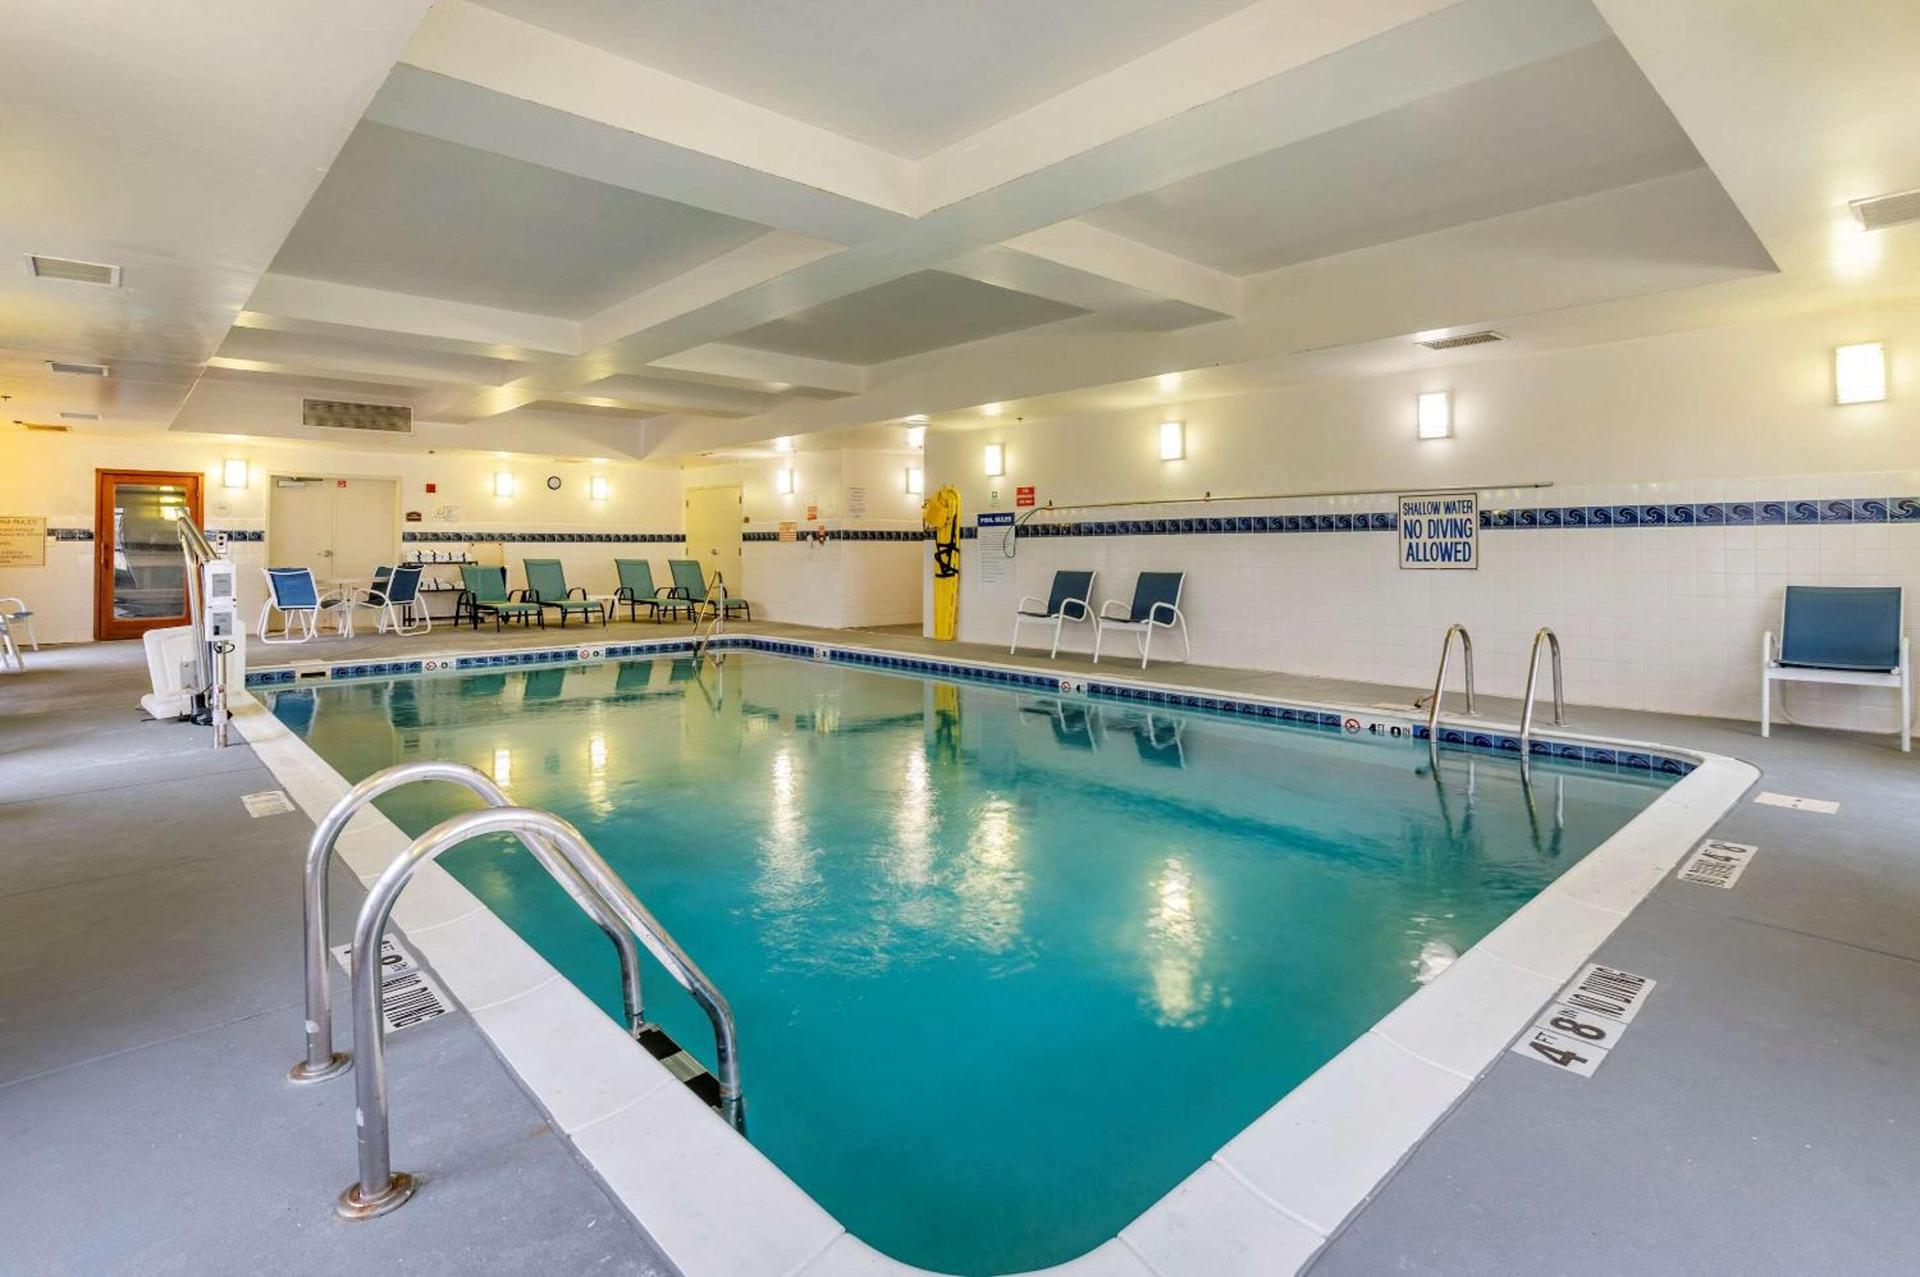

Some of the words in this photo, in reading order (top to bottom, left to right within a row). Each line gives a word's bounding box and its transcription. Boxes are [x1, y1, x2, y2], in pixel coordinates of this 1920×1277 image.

[1402, 501, 1440, 516] SHALLOW
[1443, 500, 1473, 515] WATER
[1403, 519, 1423, 539] NO
[1427, 518, 1473, 539] DIVING
[1406, 541, 1471, 562] ALLOWED
[1578, 967, 1646, 1004] DIVING
[383, 986, 446, 1028] DIVING
[1567, 993, 1626, 1019] NO
[1550, 1017, 1606, 1040] 8
[1529, 1041, 1588, 1067] 4
